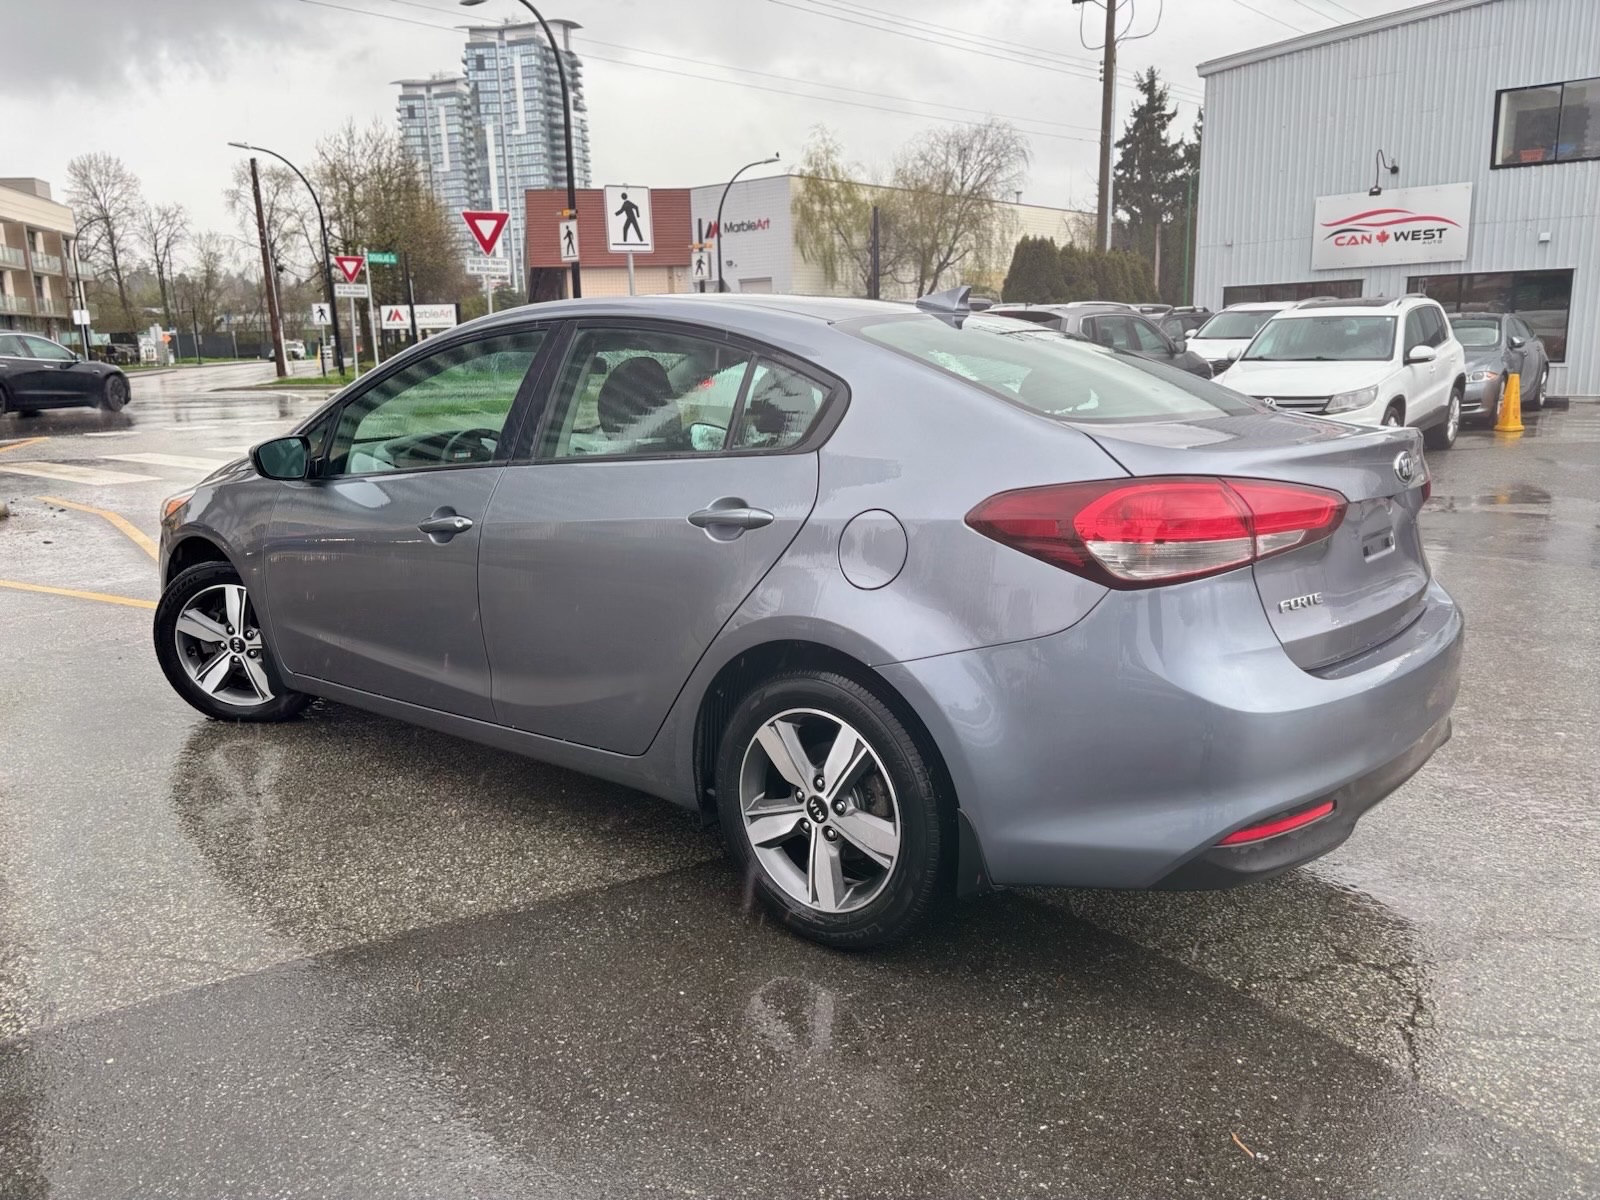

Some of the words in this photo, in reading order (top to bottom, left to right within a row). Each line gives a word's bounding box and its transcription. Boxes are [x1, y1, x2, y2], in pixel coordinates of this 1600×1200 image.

[724, 219, 770, 233] MarbleArt
[1334, 234, 1373, 247] CAN
[1394, 228, 1448, 242] WEST
[1278, 592, 1323, 613] FORTE
[810, 798, 825, 820] KIA
